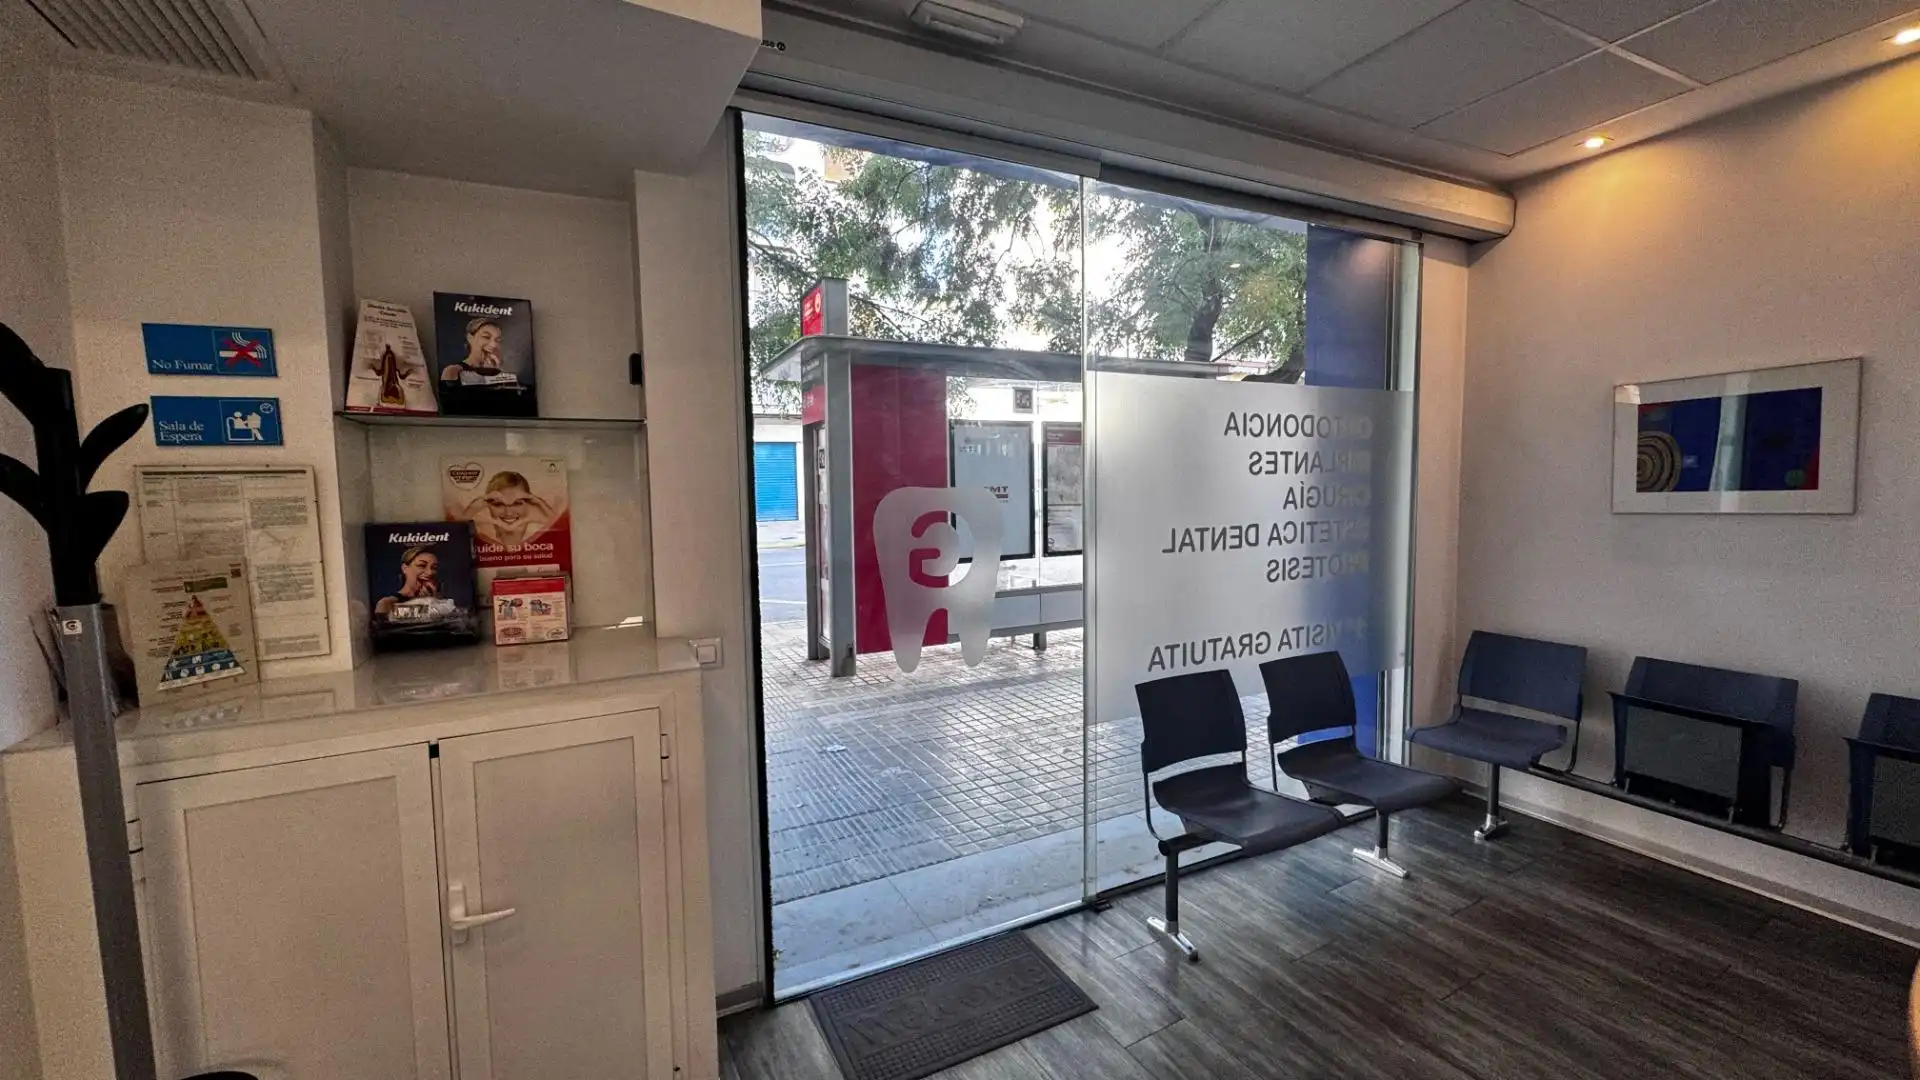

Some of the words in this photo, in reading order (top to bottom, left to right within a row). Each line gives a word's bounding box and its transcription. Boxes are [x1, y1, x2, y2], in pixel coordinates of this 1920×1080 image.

[454, 301, 513, 316] Kukident
[152, 359, 172, 370] No
[175, 360, 214, 371] Fumar
[159, 420, 183, 432] Sala
[186, 421, 204, 432] de
[159, 431, 204, 445] Espera
[388, 532, 450, 544] Kukident
[507, 543, 522, 553] su
[524, 541, 554, 552] boca
[504, 554, 522, 562] para
